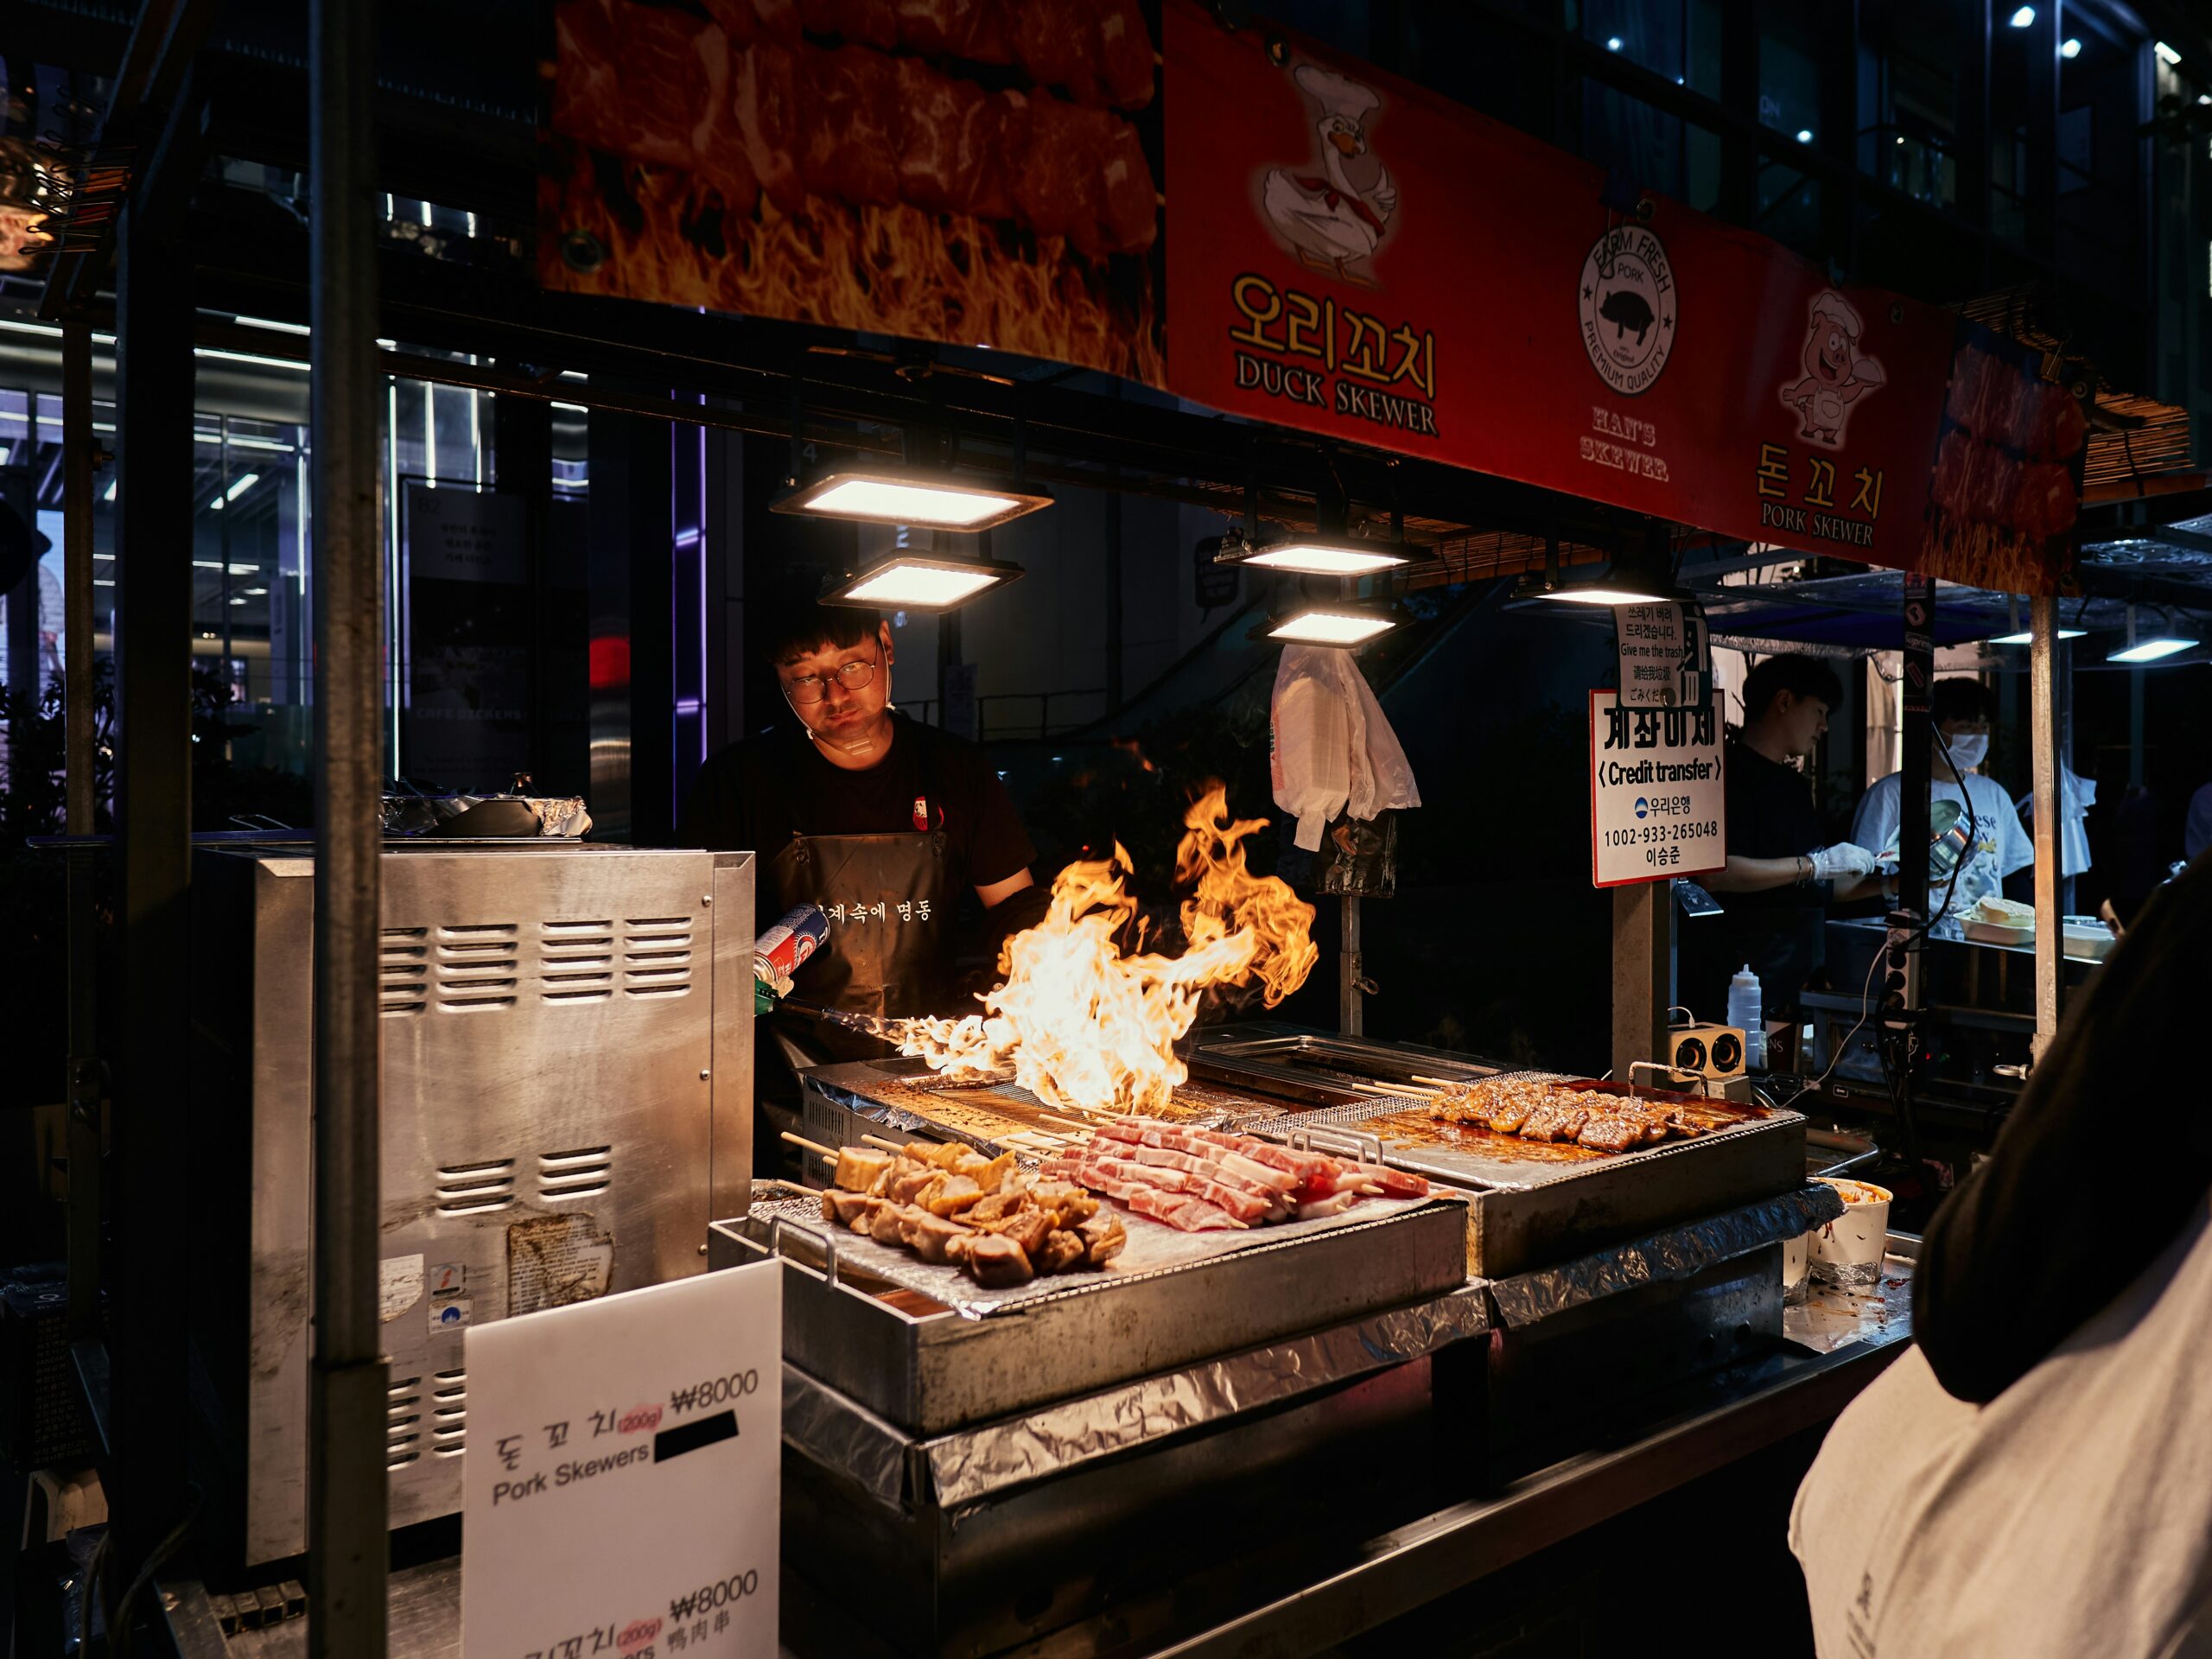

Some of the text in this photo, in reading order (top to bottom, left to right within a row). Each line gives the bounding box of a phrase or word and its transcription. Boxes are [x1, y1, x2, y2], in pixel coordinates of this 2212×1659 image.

[1618, 262, 1643, 283] PORK
[1637, 234, 1671, 294] FRESH
[1230, 275, 1436, 400] 오리꼬치
[1584, 321, 1665, 391] PREMIUM QUALITY
[1237, 353, 1438, 435] DUCK SKEWER
[1579, 435, 1669, 483] SKEWER
[1762, 502, 1873, 547] PORK SKEWER
[1628, 606, 1673, 622] 쓰레기 버려
[1620, 643, 1637, 657] Give
[1639, 646, 1650, 658] me
[1651, 644, 1663, 658] the
[1649, 796, 1691, 817] 우리은행
[1605, 821, 1718, 847] 1002-933-265048
[1646, 846, 1681, 867] 이승준
[817, 901, 887, 925] 계속에
[896, 899, 932, 922] 명동
[492, 1443, 650, 1507] Pork Skewers
